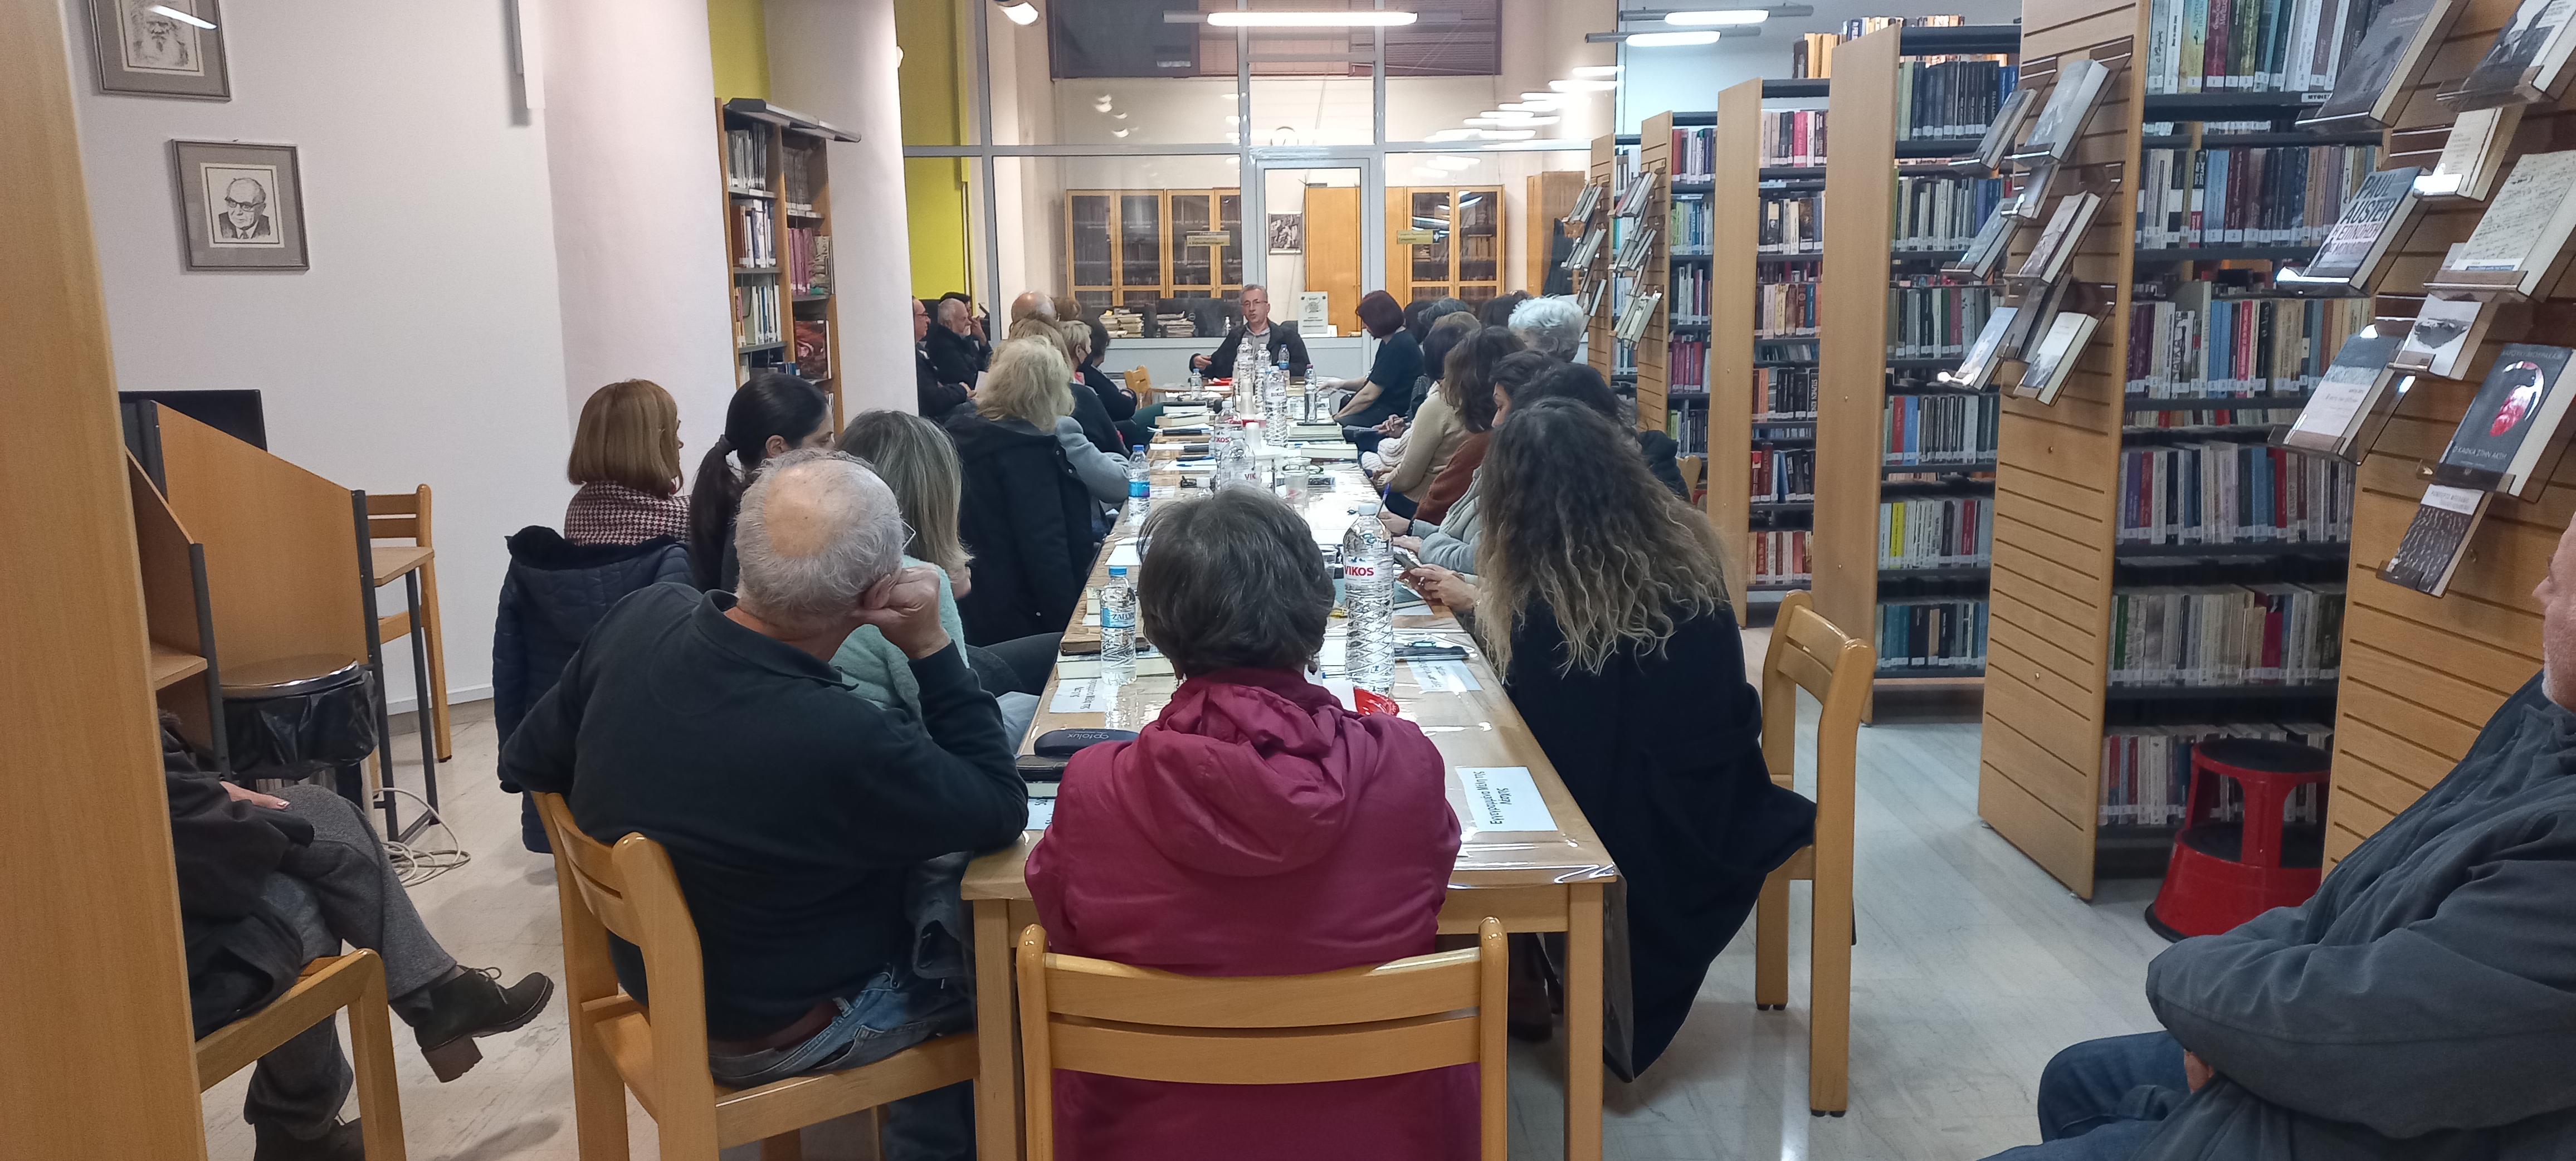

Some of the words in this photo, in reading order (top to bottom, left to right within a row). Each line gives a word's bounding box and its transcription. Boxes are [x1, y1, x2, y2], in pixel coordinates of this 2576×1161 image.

[2357, 174, 2396, 199] PAUL
[2340, 198, 2397, 224] AUSTER
[1344, 565, 1374, 576] VIKOS
[1472, 770, 1486, 779] της
[1475, 778, 1489, 791] Μέλη
[1496, 787, 1513, 805] Λέσχης
